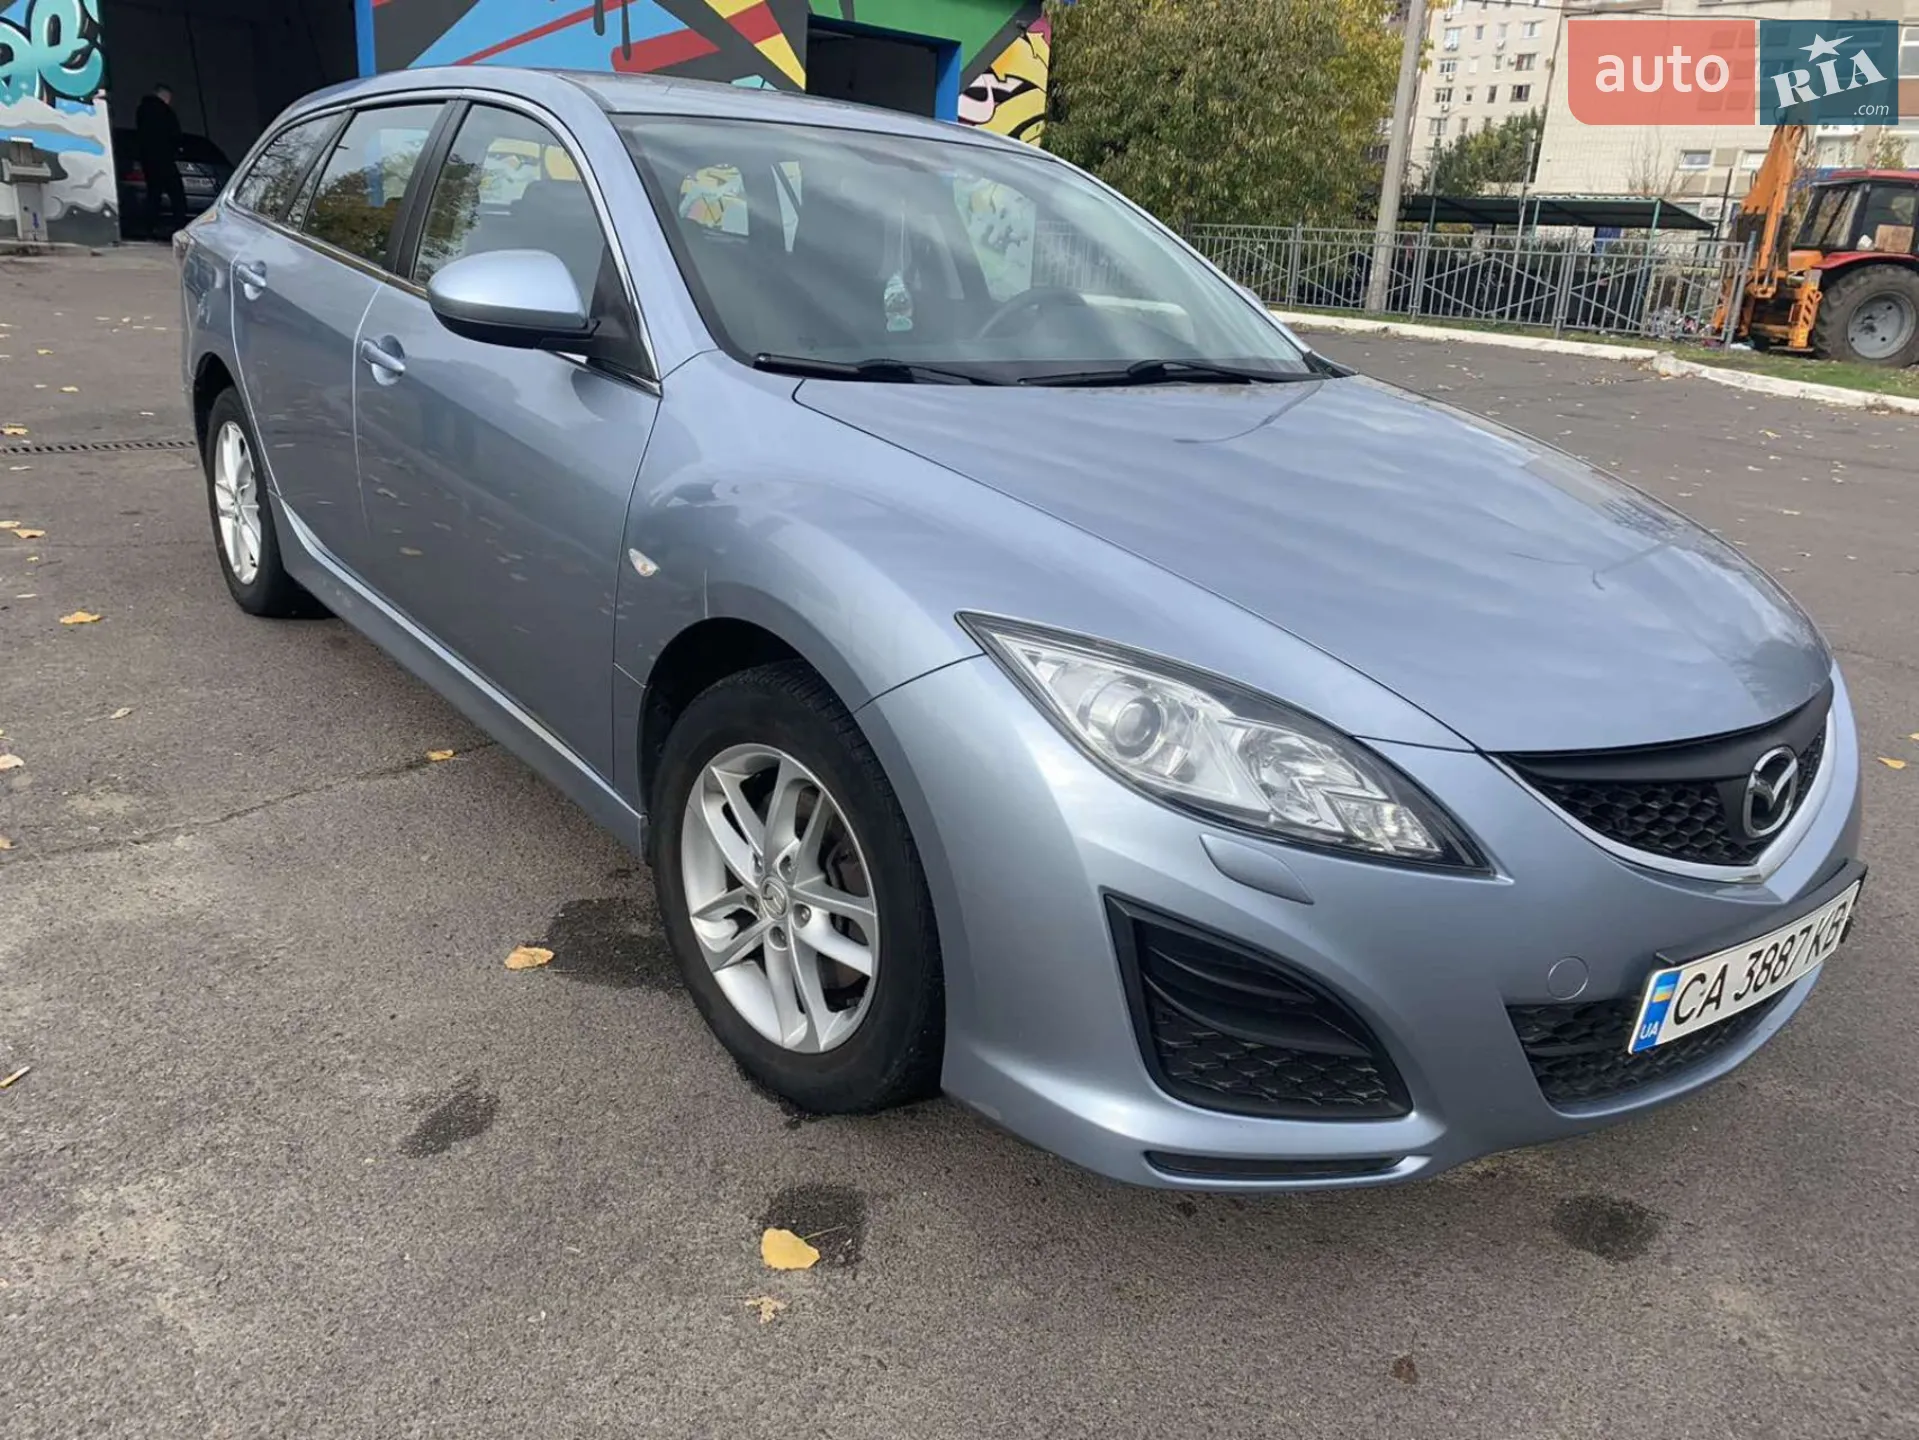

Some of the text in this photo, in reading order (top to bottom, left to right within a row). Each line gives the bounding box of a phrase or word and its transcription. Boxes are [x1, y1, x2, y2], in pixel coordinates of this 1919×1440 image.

[1673, 901, 1848, 1025] CA 3887 KB
[1639, 1020, 1660, 1040] UA
